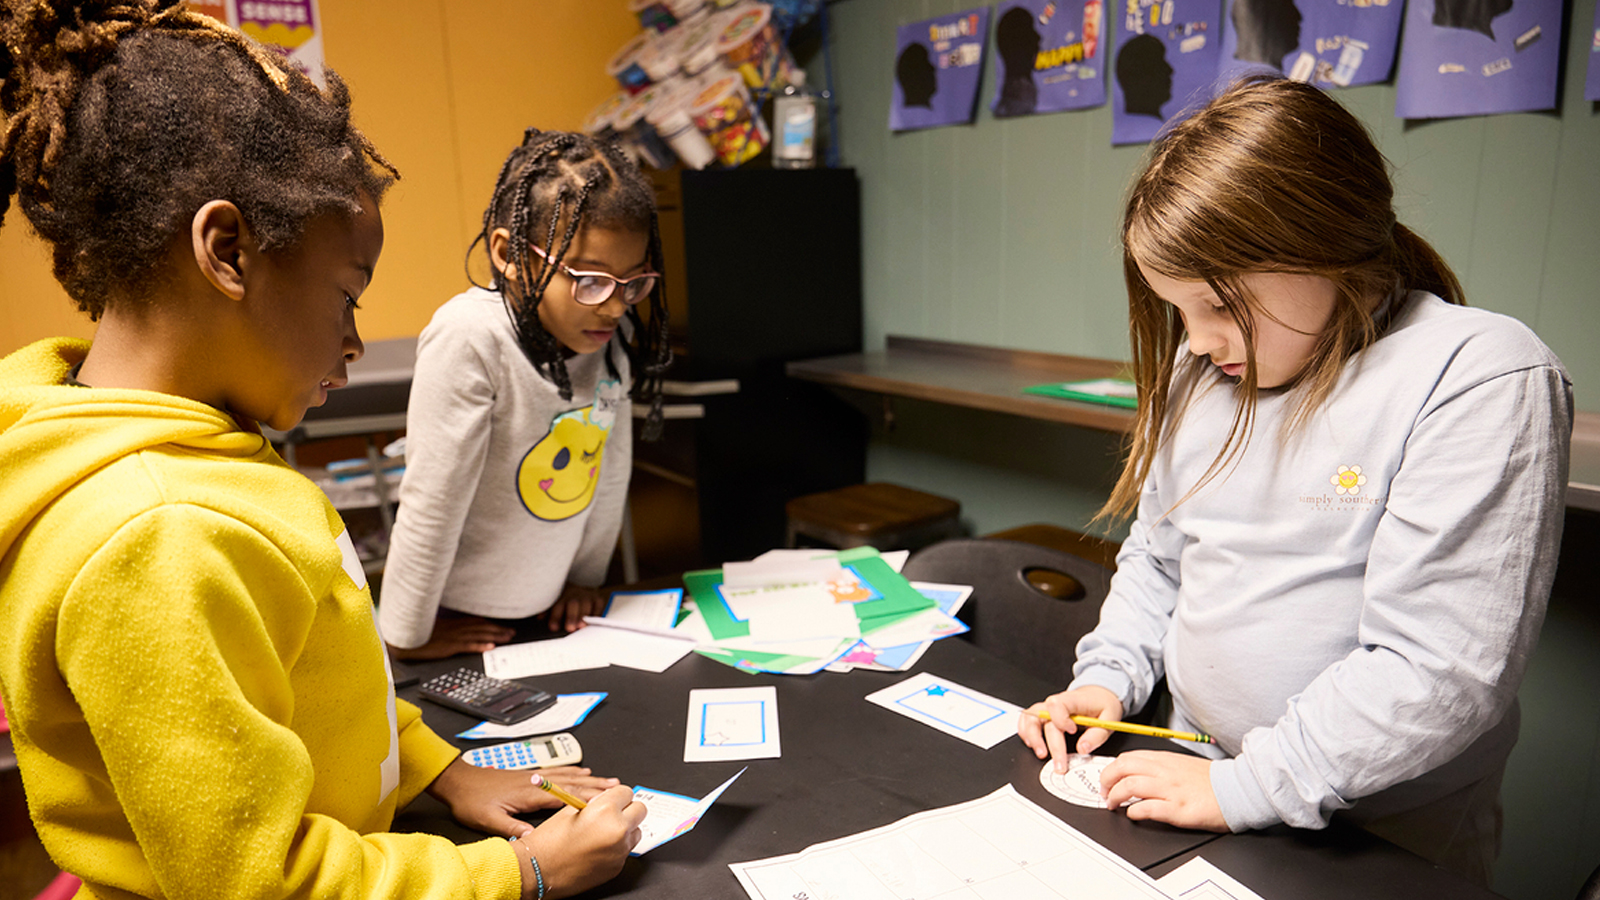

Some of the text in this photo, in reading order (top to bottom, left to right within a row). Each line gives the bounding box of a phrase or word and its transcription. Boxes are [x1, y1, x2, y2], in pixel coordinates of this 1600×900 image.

[241, 4, 308, 23] SENSE
[1034, 42, 1084, 70] HAPPY
[1299, 493, 1333, 507] simply
